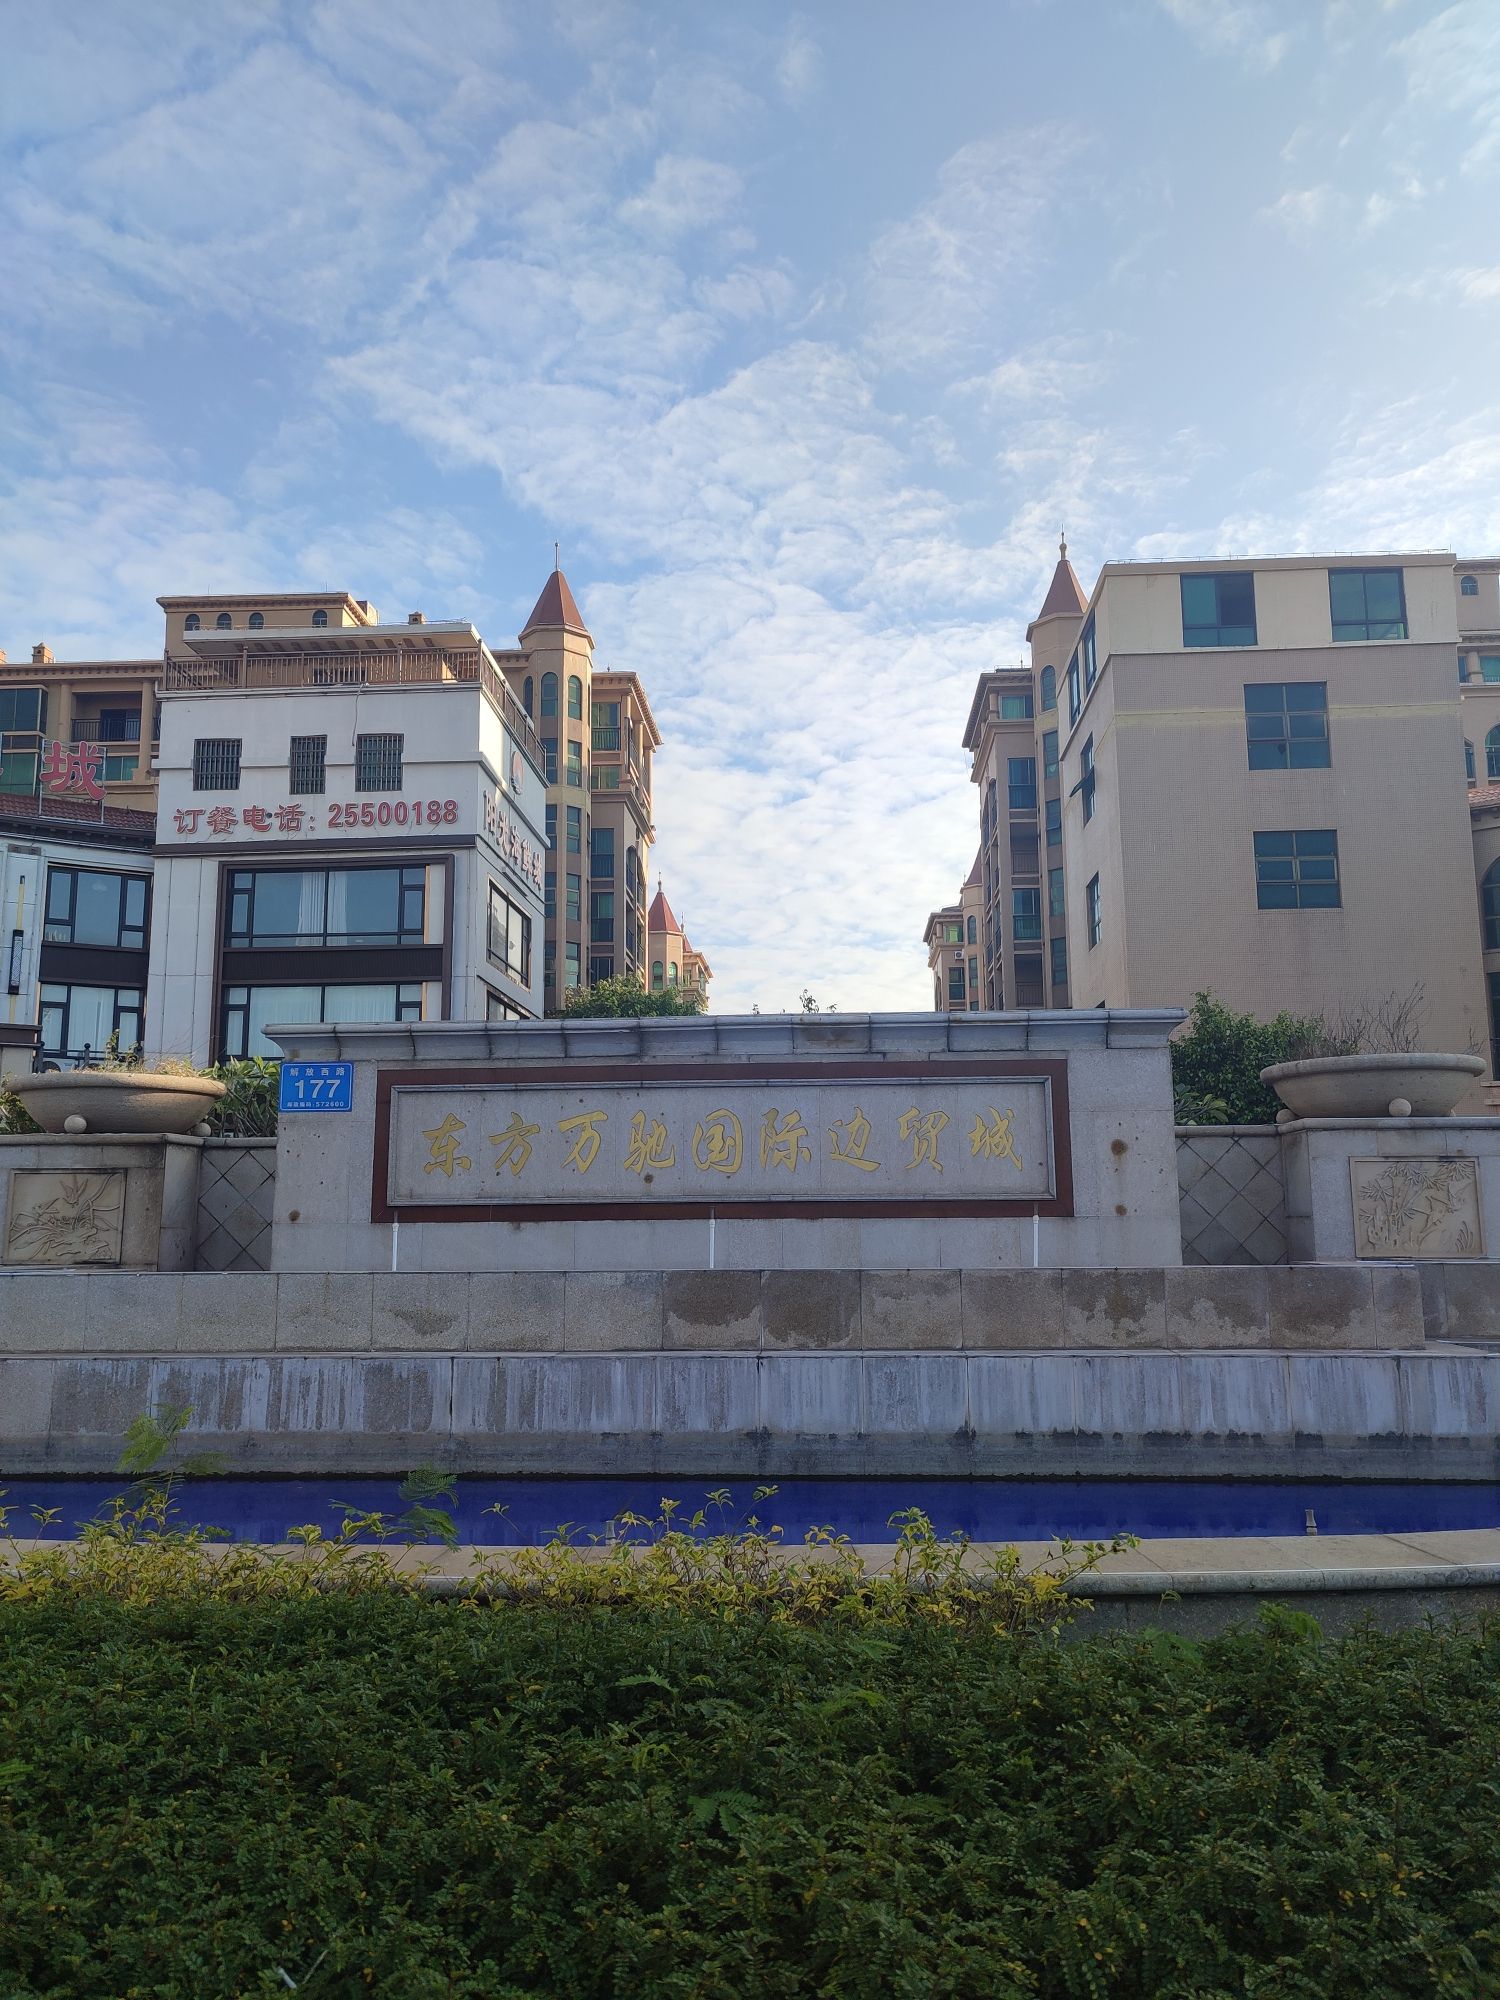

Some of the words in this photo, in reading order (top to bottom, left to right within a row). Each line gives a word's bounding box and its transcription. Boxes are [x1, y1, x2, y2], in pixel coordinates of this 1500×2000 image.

[0, 741, 107, 800] 城
[290, 1067, 345, 1077] 解放西路
[295, 1080, 341, 1099] 177
